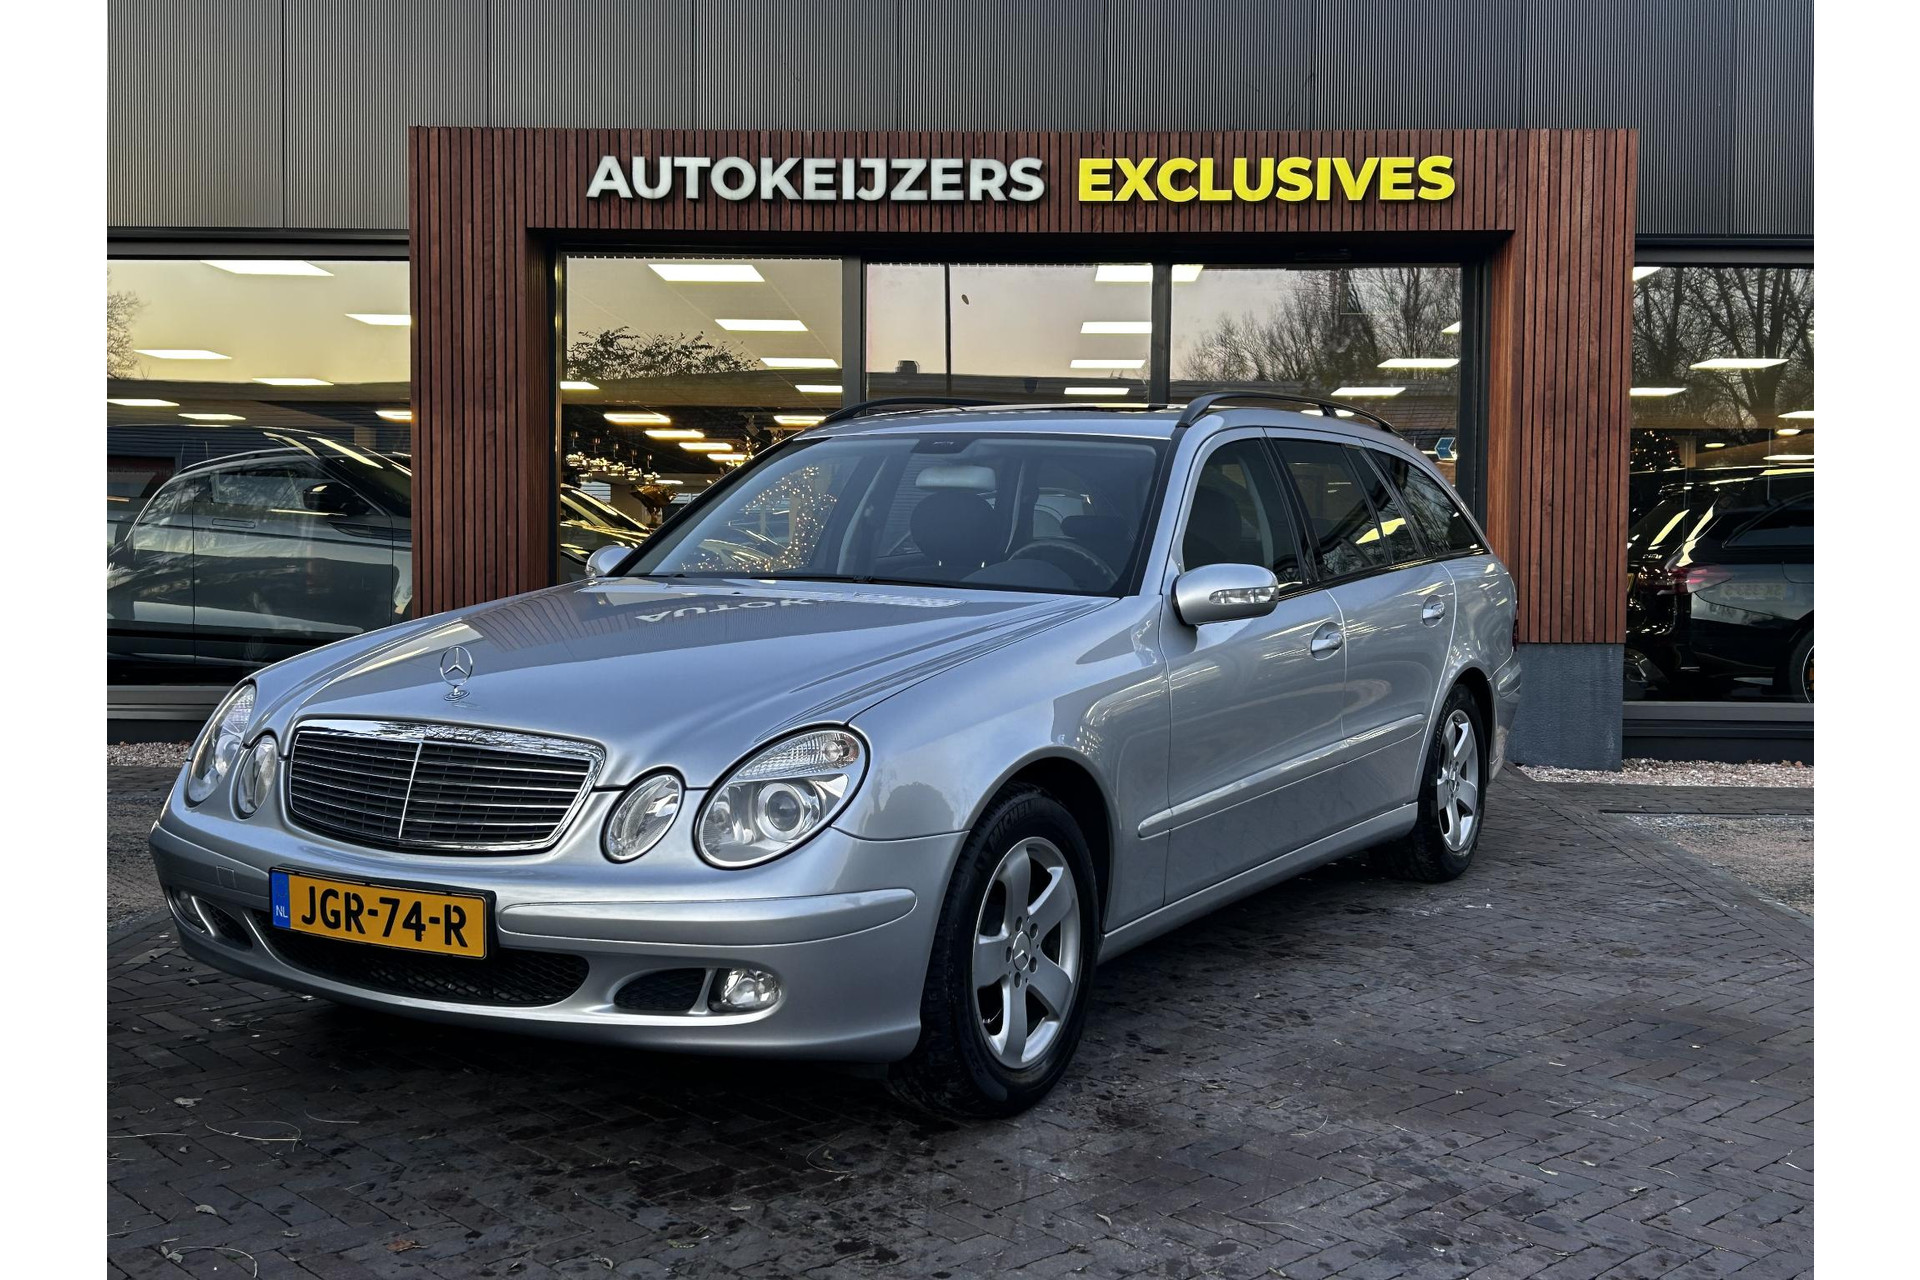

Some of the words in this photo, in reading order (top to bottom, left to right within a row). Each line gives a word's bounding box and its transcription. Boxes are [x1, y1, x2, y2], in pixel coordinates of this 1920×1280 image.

[586, 155, 1045, 202] AUTOKEIJZERS
[1078, 155, 1456, 202] EXCLUSIVES
[275, 904, 289, 919] NL
[301, 885, 469, 948] JGR-74-R
